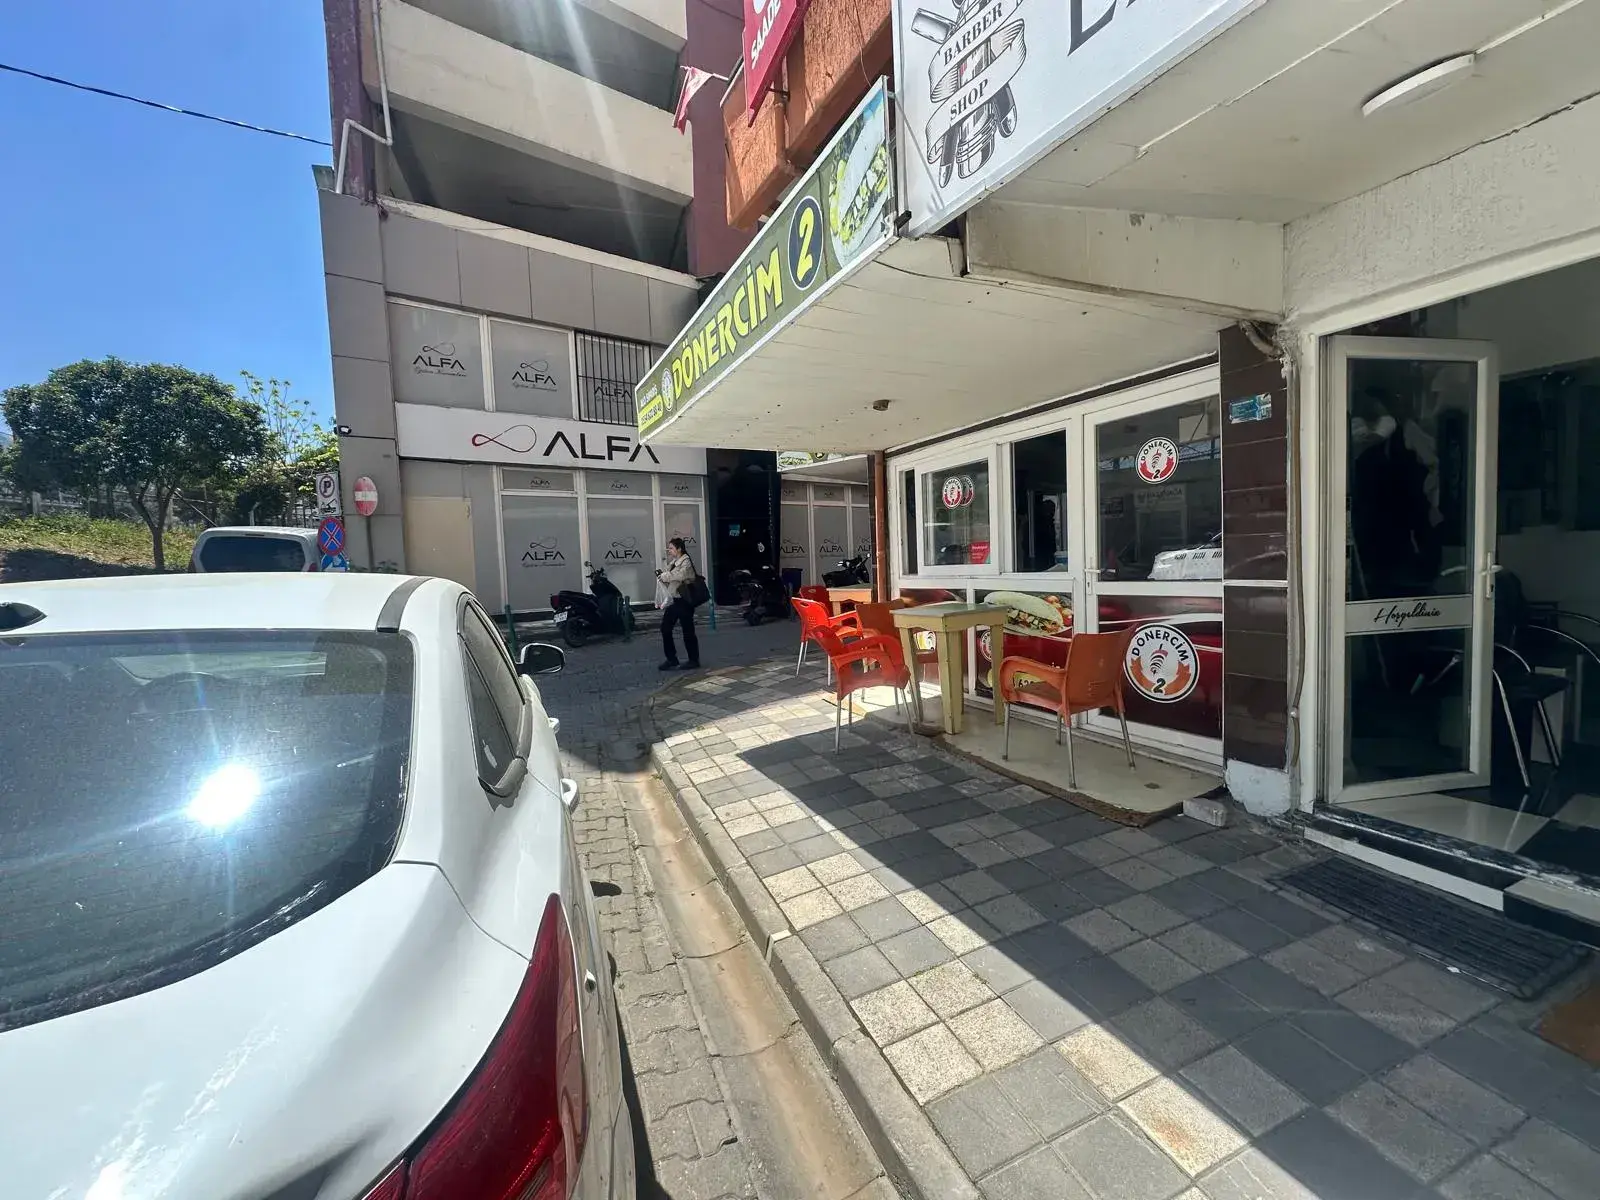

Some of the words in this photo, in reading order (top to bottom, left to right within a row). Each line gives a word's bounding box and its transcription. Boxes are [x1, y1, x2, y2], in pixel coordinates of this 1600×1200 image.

[942, 5, 1003, 64] BARBER
[949, 78, 990, 122] SHOP
[672, 245, 785, 400] DÖNERCİM
[796, 206, 816, 282] 2
[413, 354, 466, 371] ALFA
[511, 370, 557, 386] ALFA
[542, 430, 661, 464] ALFA
[1153, 469, 1161, 479] 2
[521, 551, 565, 561] ALFA
[604, 549, 643, 560] ALFA
[1131, 629, 1189, 662] DÖNERCİM
[1152, 677, 1166, 694] 2
